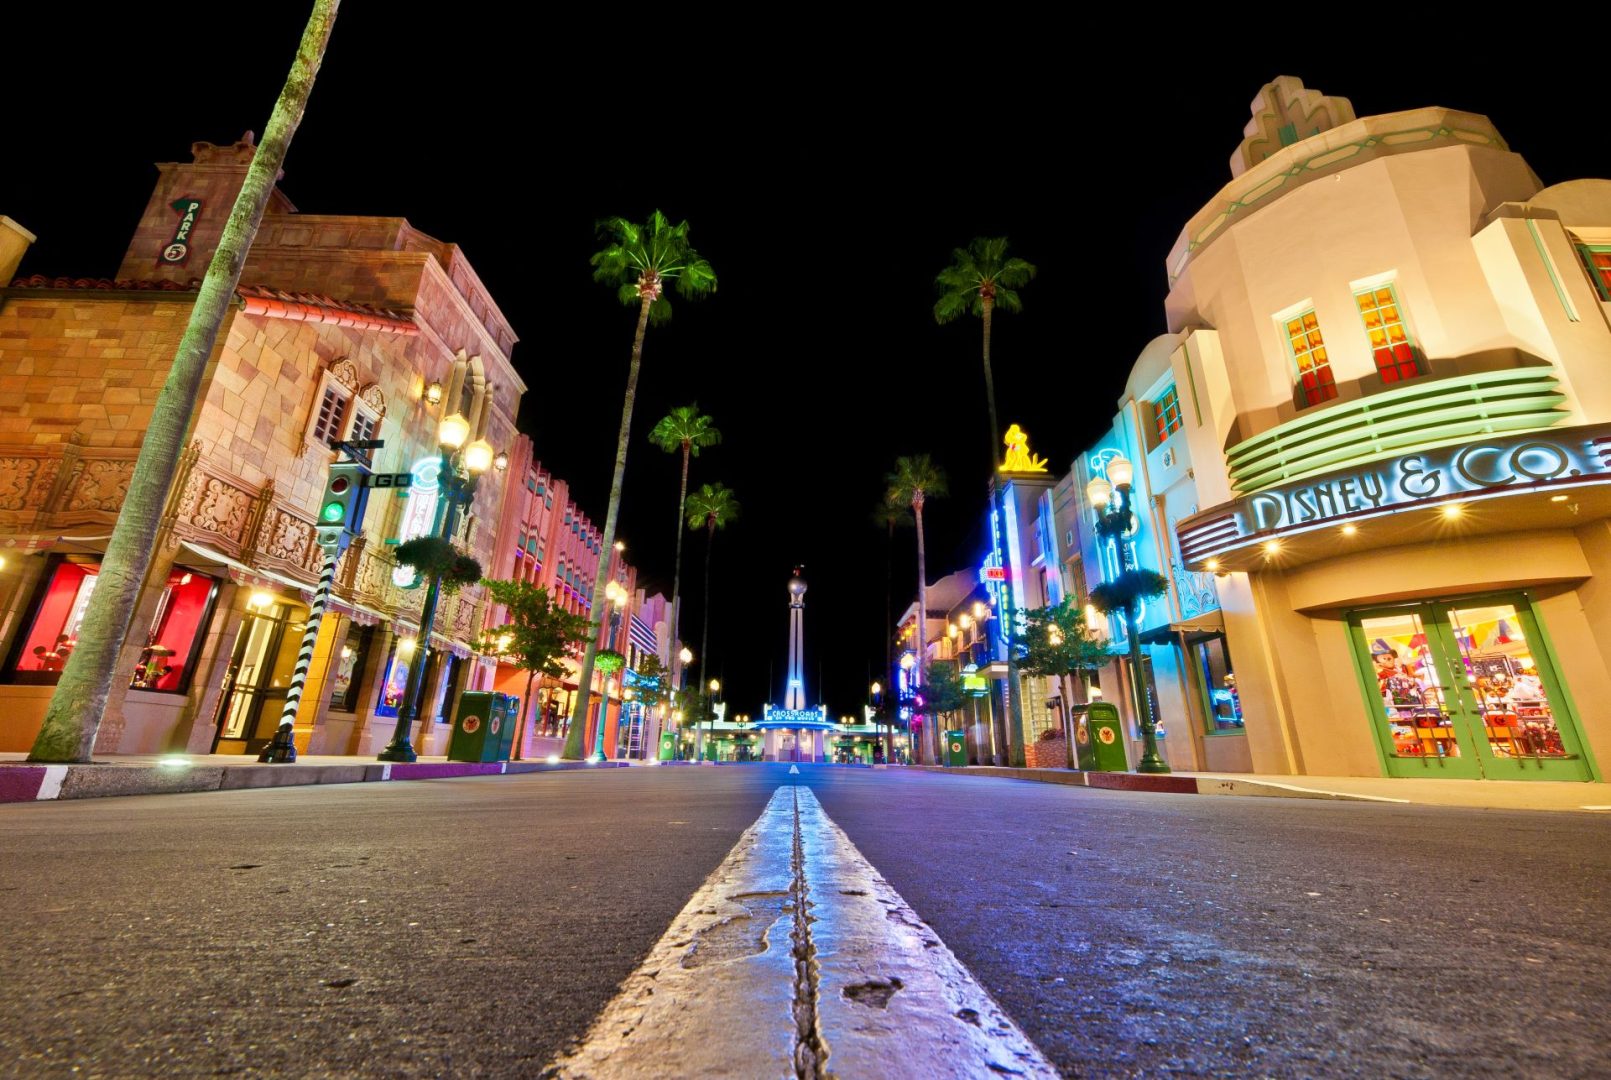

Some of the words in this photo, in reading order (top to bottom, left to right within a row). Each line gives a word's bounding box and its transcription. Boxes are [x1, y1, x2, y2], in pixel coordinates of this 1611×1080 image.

[177, 203, 199, 240] PARK
[374, 473, 409, 488] GO
[1251, 471, 1384, 531] DISNEY
[1399, 455, 1441, 499] &
[1456, 441, 1582, 488] CO.
